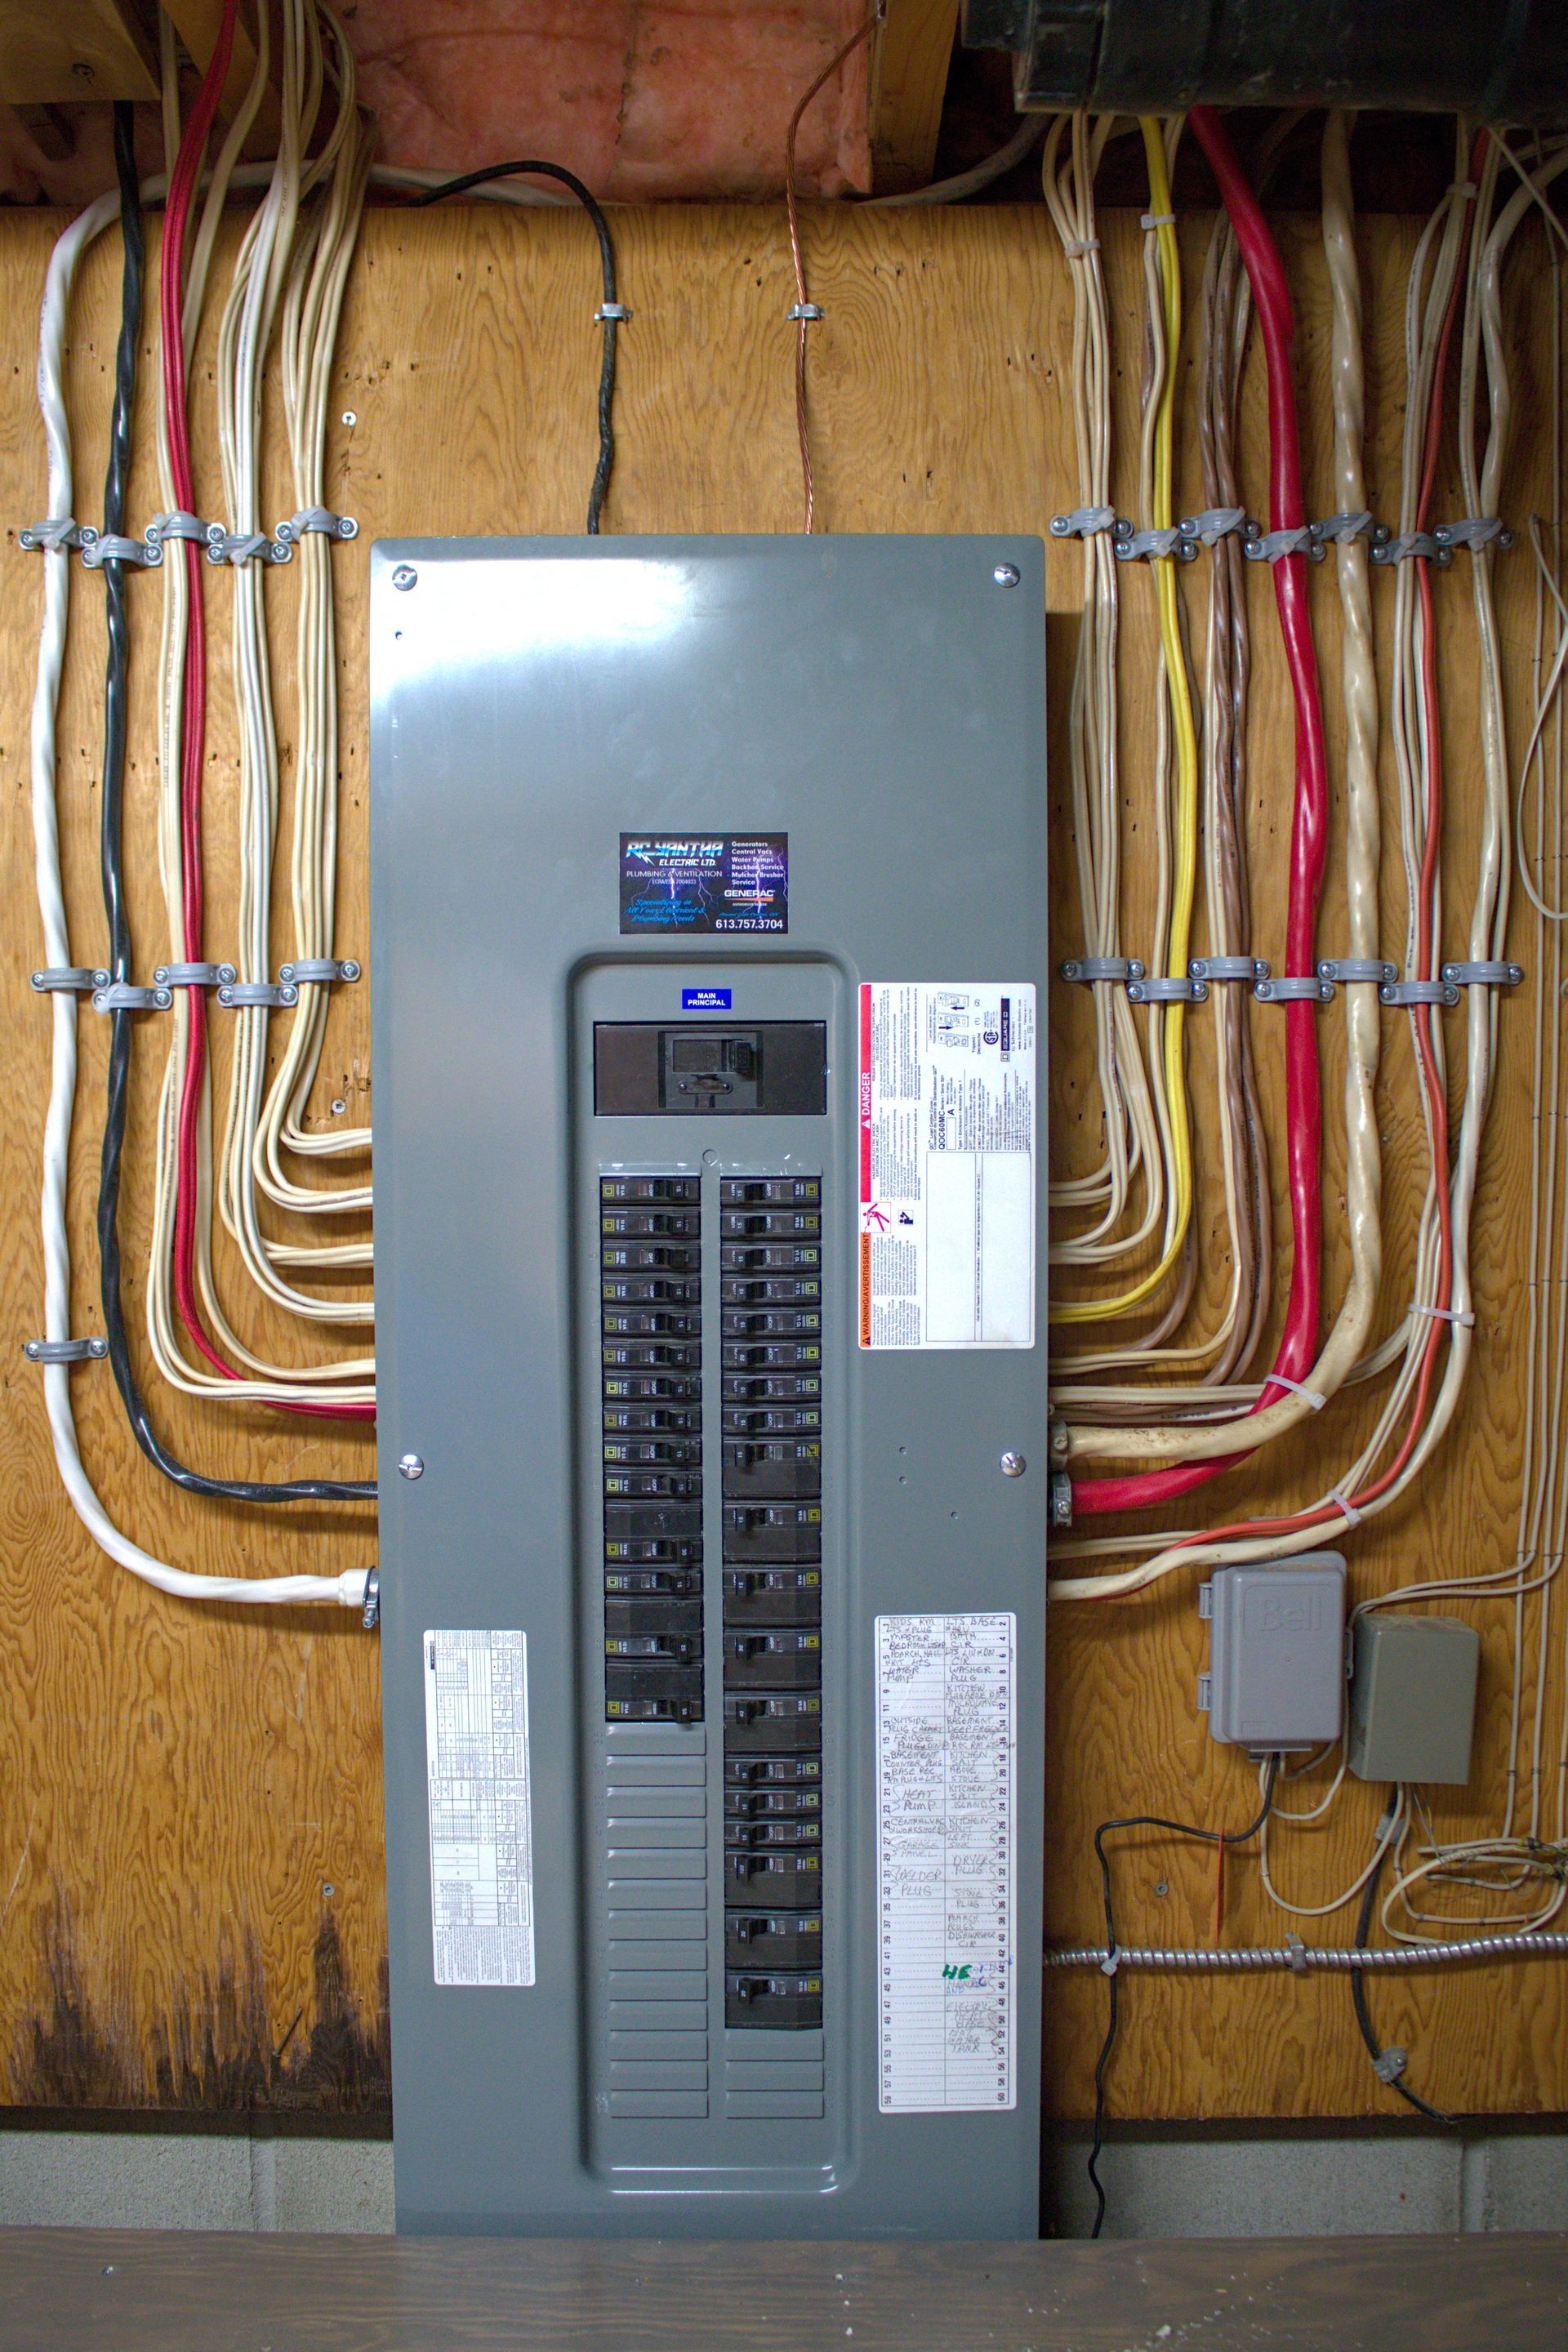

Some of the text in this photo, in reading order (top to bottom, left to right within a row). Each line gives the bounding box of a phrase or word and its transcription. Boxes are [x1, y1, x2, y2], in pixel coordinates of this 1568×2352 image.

[655, 841, 724, 858] YANTHA
[632, 915, 670, 924] Plumbing
[715, 920, 783, 929] 613.757.3704
[862, 1072, 871, 1116] DANGER
[1258, 1594, 1321, 1631] Bell
[970, 1617, 996, 1626] BASE
[890, 1633, 929, 1642] MASTER
[949, 1666, 991, 1674] WASHER
[951, 1673, 977, 1682] PLUG
[954, 1706, 978, 1716] PLUG
[947, 1717, 993, 1725] BASEMENT
[948, 1725, 971, 1733] DEEP
[890, 1750, 939, 1759] BASEMENT
[949, 1750, 987, 1759] KITCHEN
[1000, 1769, 1006, 1777] 20
[949, 1784, 986, 1792] KITCHEN
[902, 1788, 934, 1800] HEAT
[904, 1800, 936, 1811] PUMP
[884, 1820, 890, 1829] 25
[949, 1816, 988, 1825] KITCHEN
[999, 1821, 1005, 1829] 26
[898, 1841, 939, 1849] GARAGE
[902, 1849, 937, 1857] PANEL
[999, 1851, 1005, 1860] 30
[896, 1869, 941, 1882] WELDER
[999, 1868, 1005, 1876] 32
[902, 1883, 931, 1896] PLUG
[884, 1903, 890, 1911] 35
[956, 1900, 979, 1908] PLUG
[884, 1920, 890, 1928] 37
[999, 1934, 1005, 1942] 40
[999, 1949, 1005, 1958] 42
[884, 1984, 890, 1992] 45
[884, 2065, 892, 2073] 55
[998, 2093, 1004, 2101] 60
